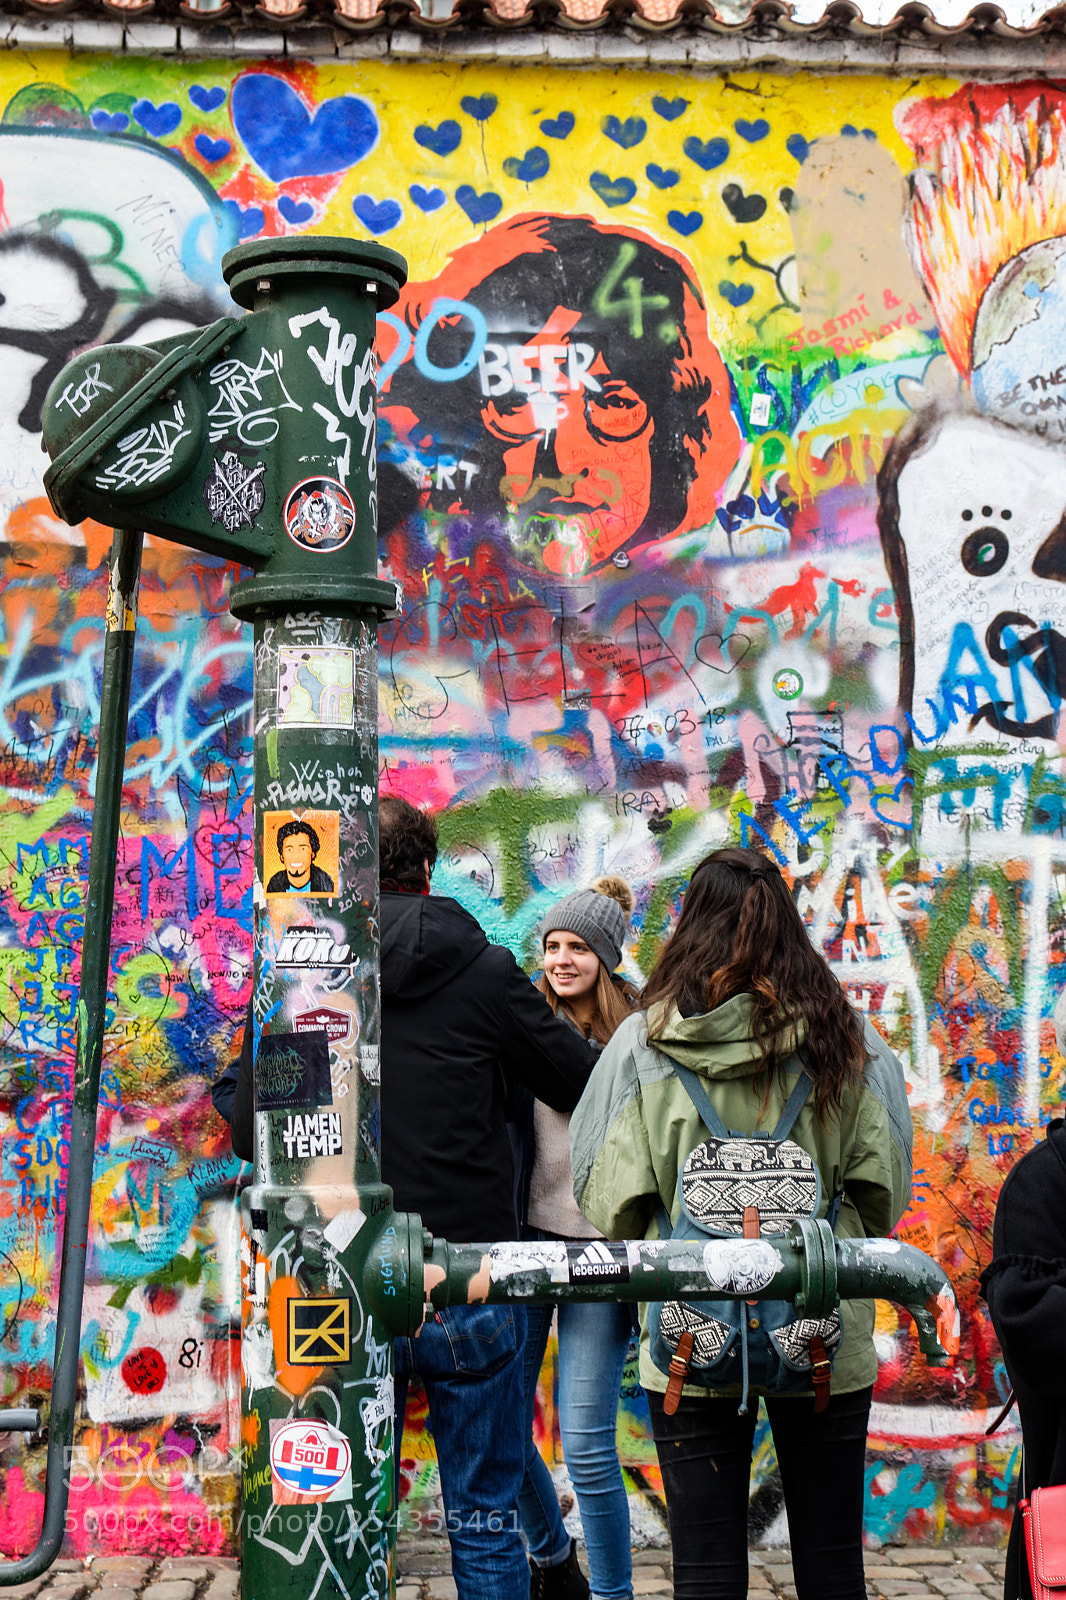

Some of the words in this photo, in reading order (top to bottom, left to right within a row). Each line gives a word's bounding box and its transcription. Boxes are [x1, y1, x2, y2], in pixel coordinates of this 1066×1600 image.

[825, 302, 923, 359] Richard
[479, 343, 602, 397] BEER
[297, 1024, 325, 1033] COMMON
[326, 1024, 348, 1032] CROWN
[282, 1112, 341, 1138] JAMEN
[282, 1134, 342, 1159] TEMP
[378, 1226, 397, 1296] SIGMUND
[572, 1263, 622, 1276] lebeauson
[294, 1449, 325, 1465] 500
